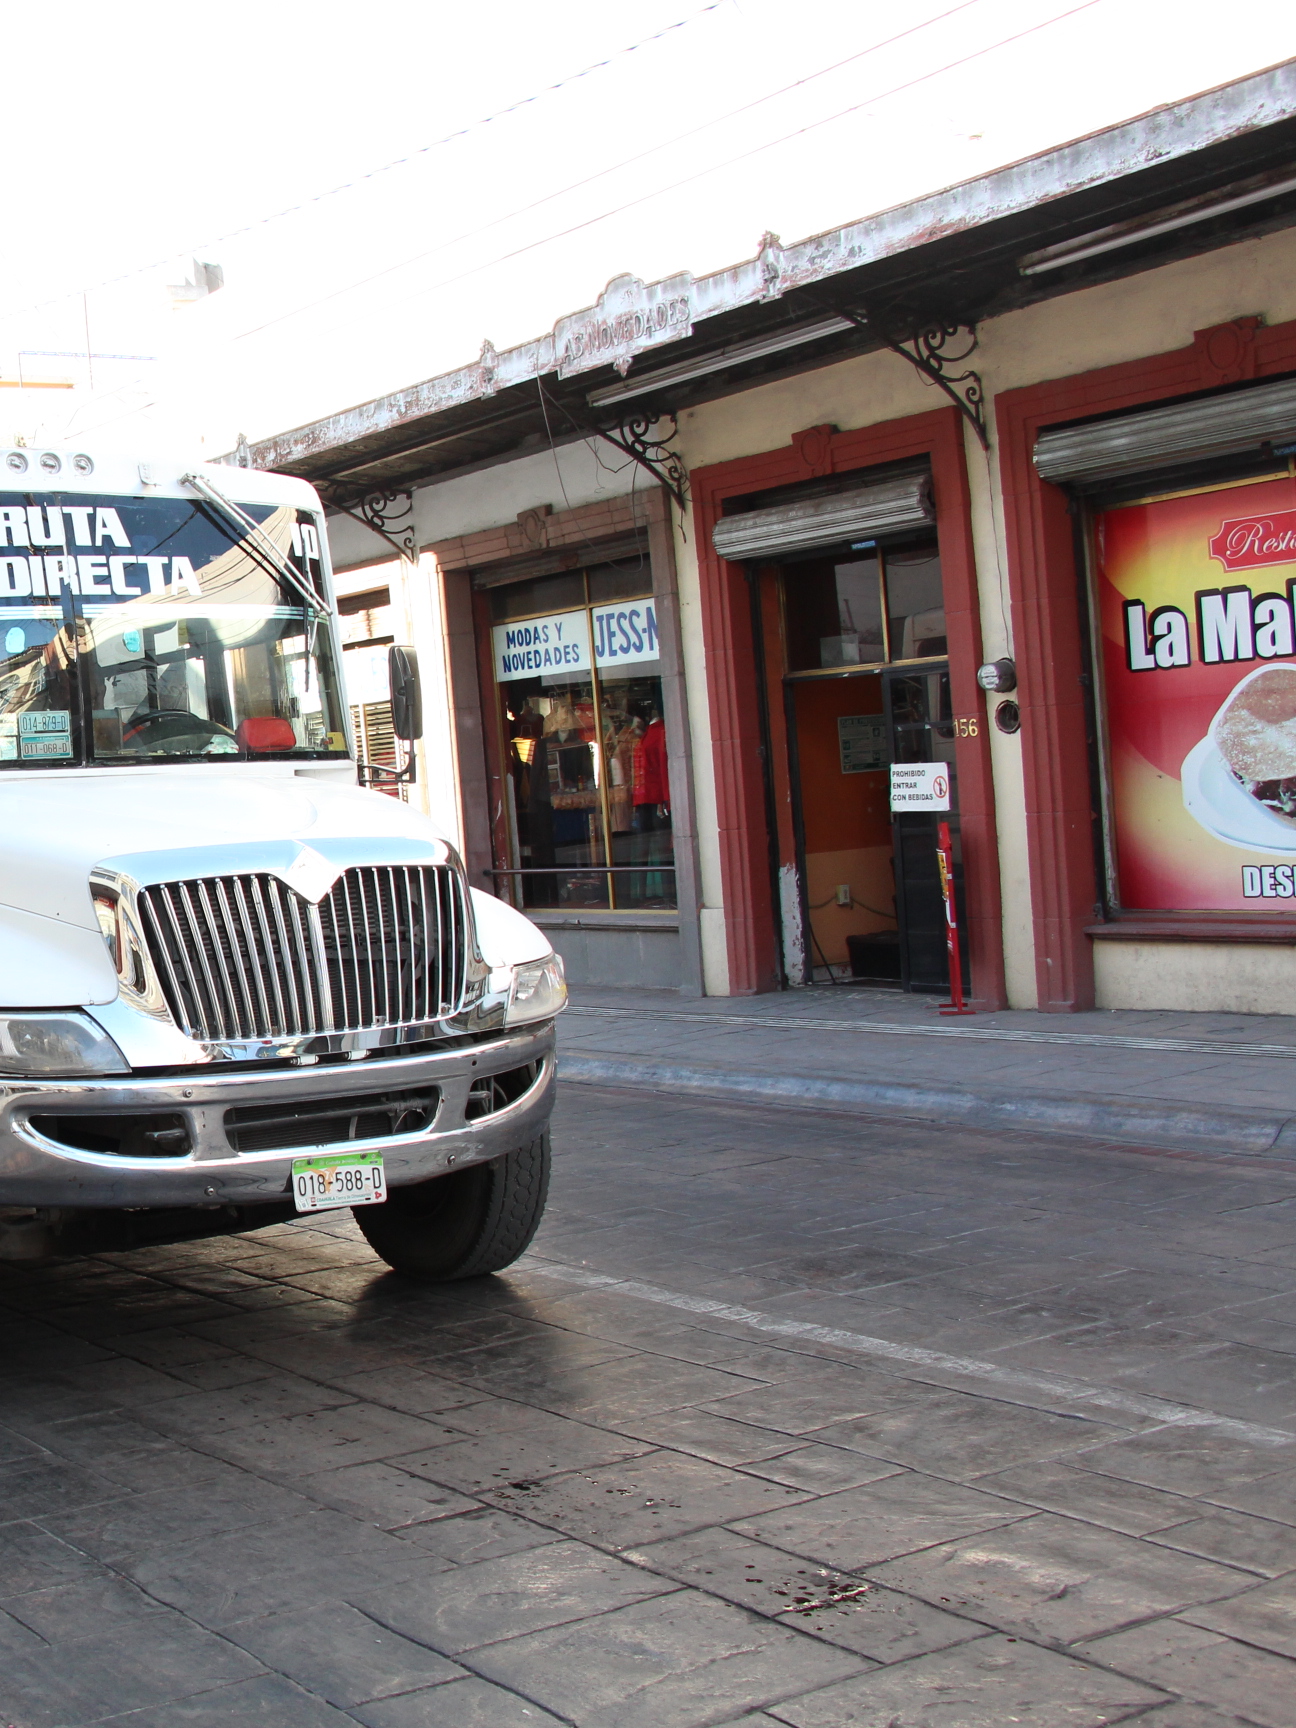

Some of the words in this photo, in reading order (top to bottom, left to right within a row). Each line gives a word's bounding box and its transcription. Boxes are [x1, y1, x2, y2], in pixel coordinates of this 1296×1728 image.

[506, 624, 549, 649] MODAS
[554, 622, 562, 641] Y
[1124, 599, 1191, 672] La
[1195, 578, 1296, 664] Ma
[502, 643, 579, 673] NOVEDADES
[22, 716, 67, 730] 014-879-D
[954, 719, 978, 737] 156
[1242, 864, 1296, 898] DES
[298, 1167, 382, 1196] 018-588-D
